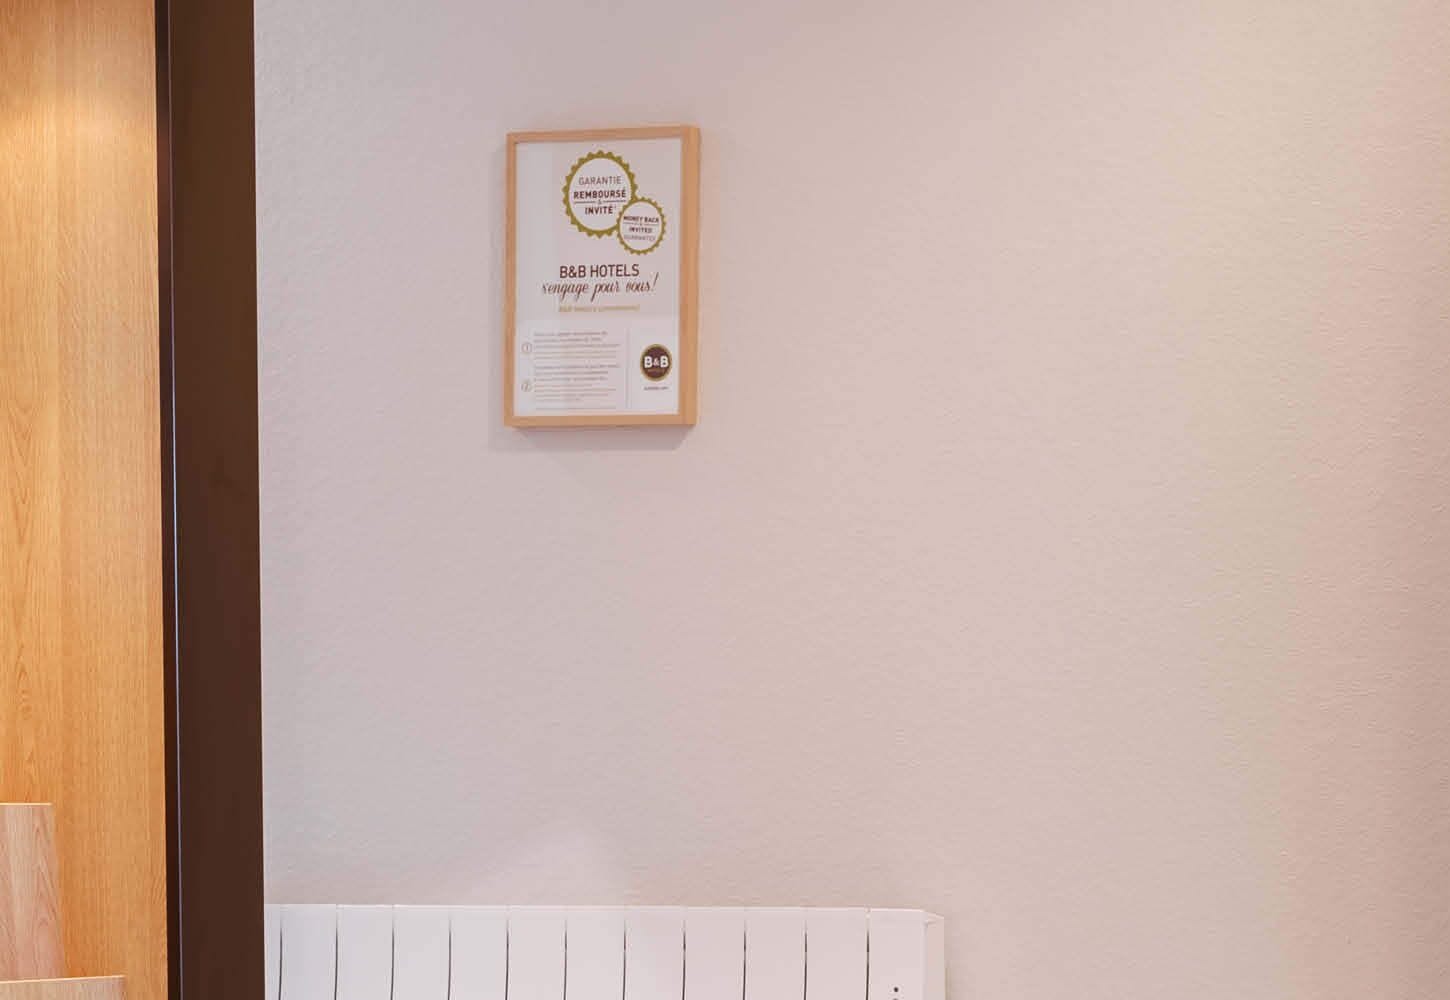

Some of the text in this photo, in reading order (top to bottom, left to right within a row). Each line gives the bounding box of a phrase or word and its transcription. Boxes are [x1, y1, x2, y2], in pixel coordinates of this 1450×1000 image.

[579, 175, 621, 186] GARANTIE
[573, 187, 627, 199] REMBOURSÉ
[560, 263, 640, 279] B&B HOTELS
[643, 356, 669, 368] B&B
